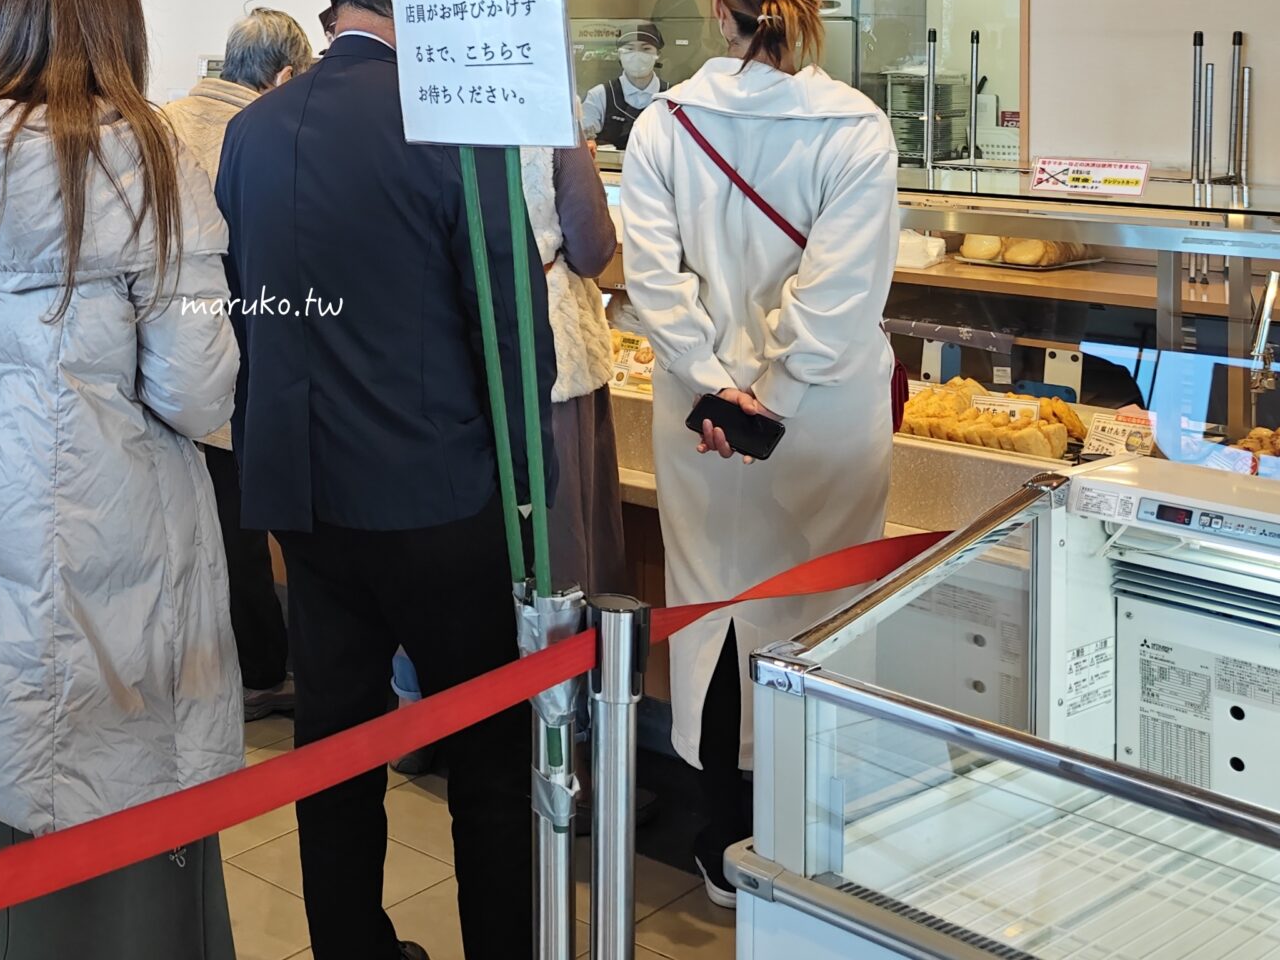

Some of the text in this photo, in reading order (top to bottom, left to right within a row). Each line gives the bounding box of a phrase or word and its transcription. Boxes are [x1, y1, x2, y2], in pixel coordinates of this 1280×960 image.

[415, 42, 532, 64] るまで、こちらで
[418, 84, 526, 105] お待ちください。
